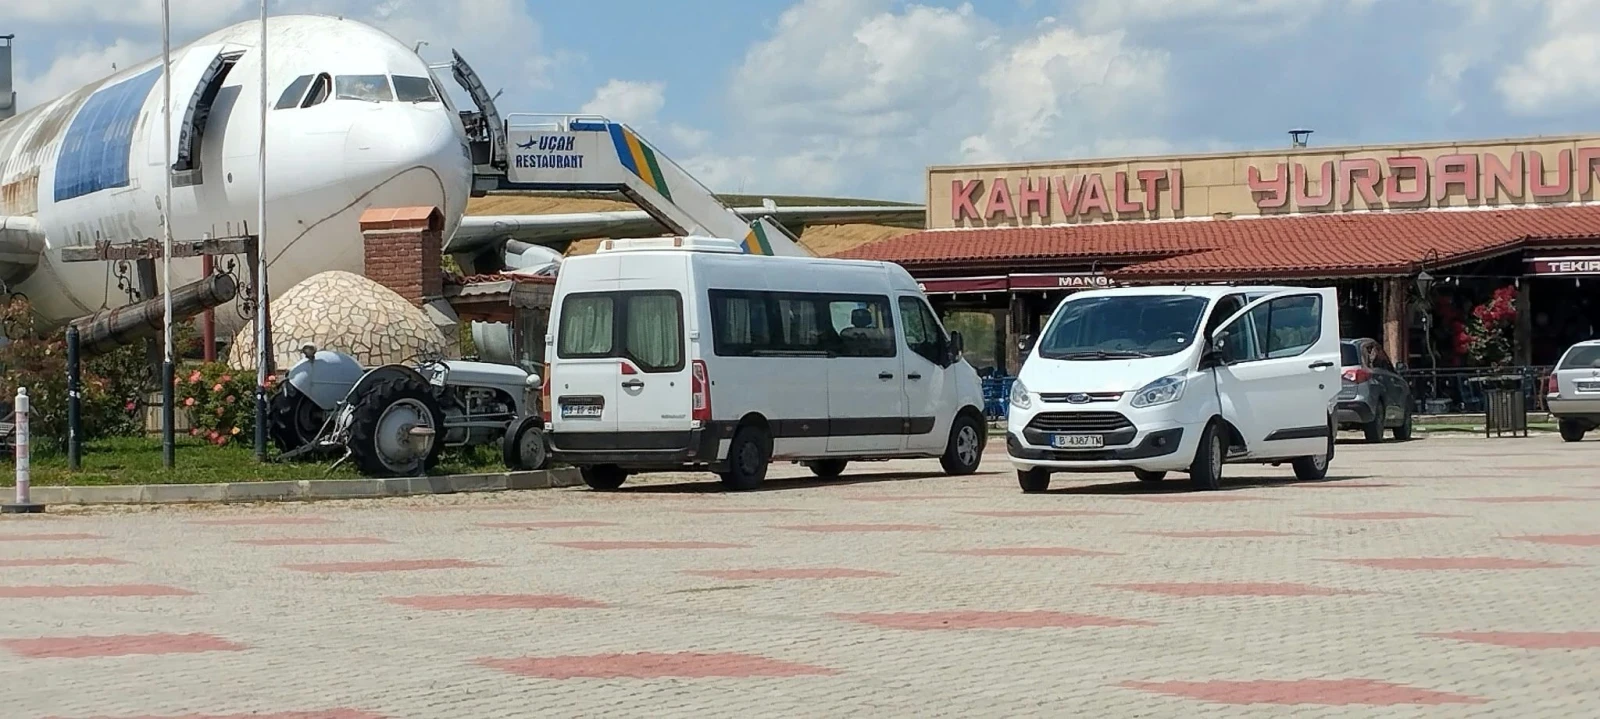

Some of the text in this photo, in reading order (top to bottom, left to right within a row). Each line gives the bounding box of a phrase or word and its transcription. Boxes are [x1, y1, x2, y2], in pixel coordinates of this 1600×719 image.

[538, 135, 576, 153] UÇAK
[515, 154, 584, 169] RESTAURANT
[951, 168, 1183, 221] KAHVALTI
